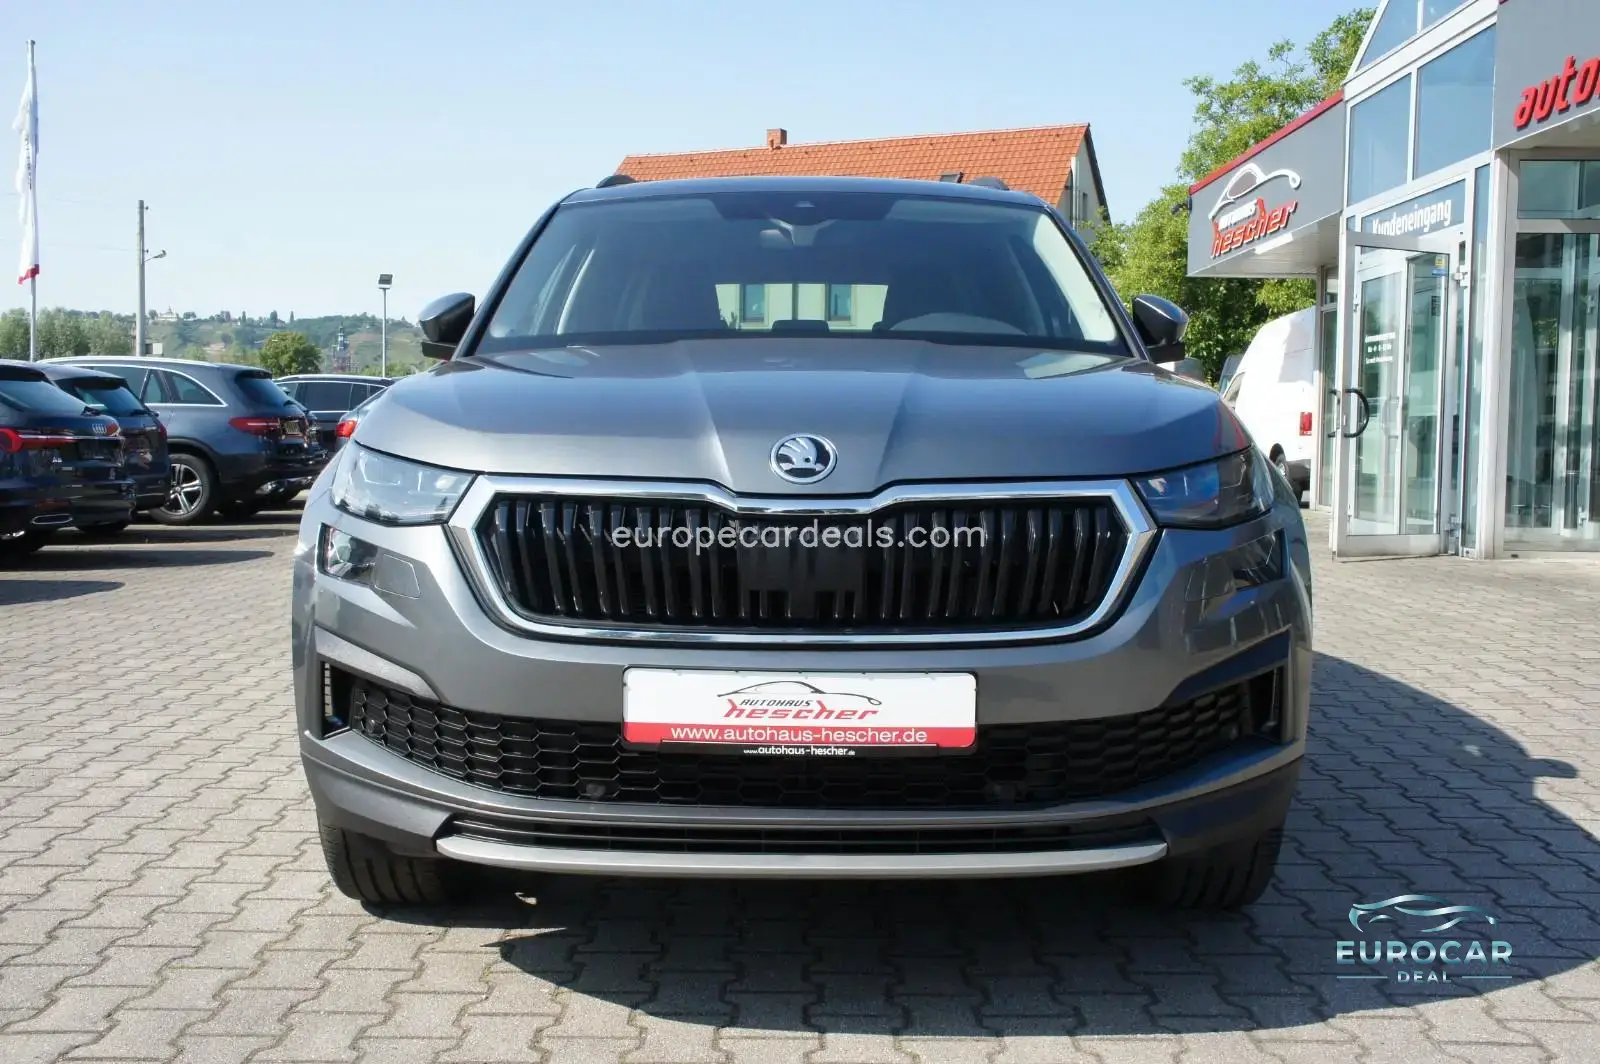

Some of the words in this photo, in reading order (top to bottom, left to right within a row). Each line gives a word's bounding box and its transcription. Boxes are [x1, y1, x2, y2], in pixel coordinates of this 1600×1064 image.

[1513, 55, 1600, 130] auto
[1211, 197, 1297, 258] hescher
[1372, 200, 1452, 236] Kundeneingang
[723, 698, 879, 720] hescher
[740, 699, 813, 707] AUTOHAUS
[671, 727, 927, 743] www.autohaus-hescher.de
[743, 745, 855, 756] www.autohaus-hescher.de
